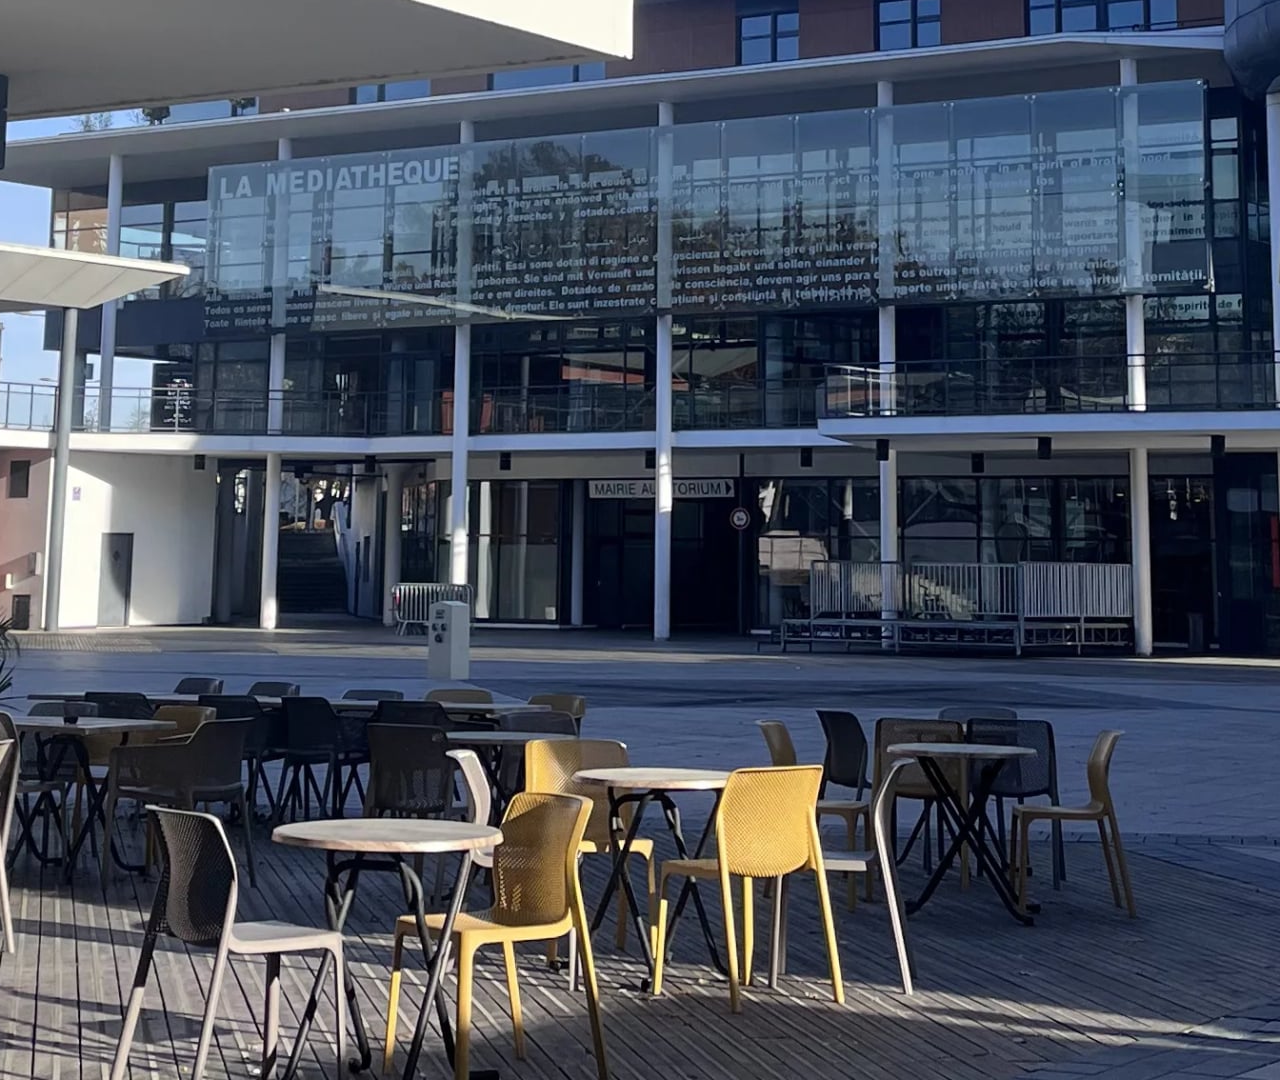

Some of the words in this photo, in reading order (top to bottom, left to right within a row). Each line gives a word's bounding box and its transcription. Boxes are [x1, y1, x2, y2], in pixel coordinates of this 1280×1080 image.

[220, 175, 253, 200] LA
[266, 156, 459, 196] MEDIATHEQUE
[508, 198, 531, 211] They
[533, 198, 551, 207] are
[555, 193, 602, 206] endowed
[505, 260, 526, 271] Essi
[529, 260, 553, 270] sono
[556, 256, 587, 268] dotati
[588, 255, 599, 266] di
[600, 254, 640, 267] ragione
[642, 254, 649, 263] e
[669, 249, 720, 261] oscienza
[723, 249, 730, 258] e
[477, 275, 521, 288] geboren.
[524, 273, 540, 283] Sie
[543, 271, 563, 282] sind
[566, 271, 584, 281] mit
[587, 267, 632, 280] Vernunft
[635, 267, 655, 278] und
[713, 261, 751, 274] begabt
[754, 260, 775, 271] und
[777, 258, 811, 270] sollen
[815, 255, 866, 268] einander
[514, 286, 556, 298] direitos.
[561, 283, 603, 295] Dotados
[607, 282, 621, 293] de
[756, 274, 792, 286] devem
[795, 273, 818, 286] agir
[821, 272, 842, 282] uns
[845, 271, 870, 284] para
[901, 268, 916, 278] os
[919, 266, 957, 278] outros
[505, 301, 547, 315] drepturi.
[549, 300, 565, 310] Ele
[567, 298, 589, 309] sunt
[1002, 278, 1017, 289] de
[204, 306, 231, 316] Todos
[233, 305, 245, 314] os
[246, 304, 271, 313] seres
[279, 301, 313, 311] manos
[204, 318, 229, 328] Toate
[300, 315, 311, 323] se
[594, 482, 636, 496] MAIRIE
[641, 481, 722, 495] AUTORIUM
